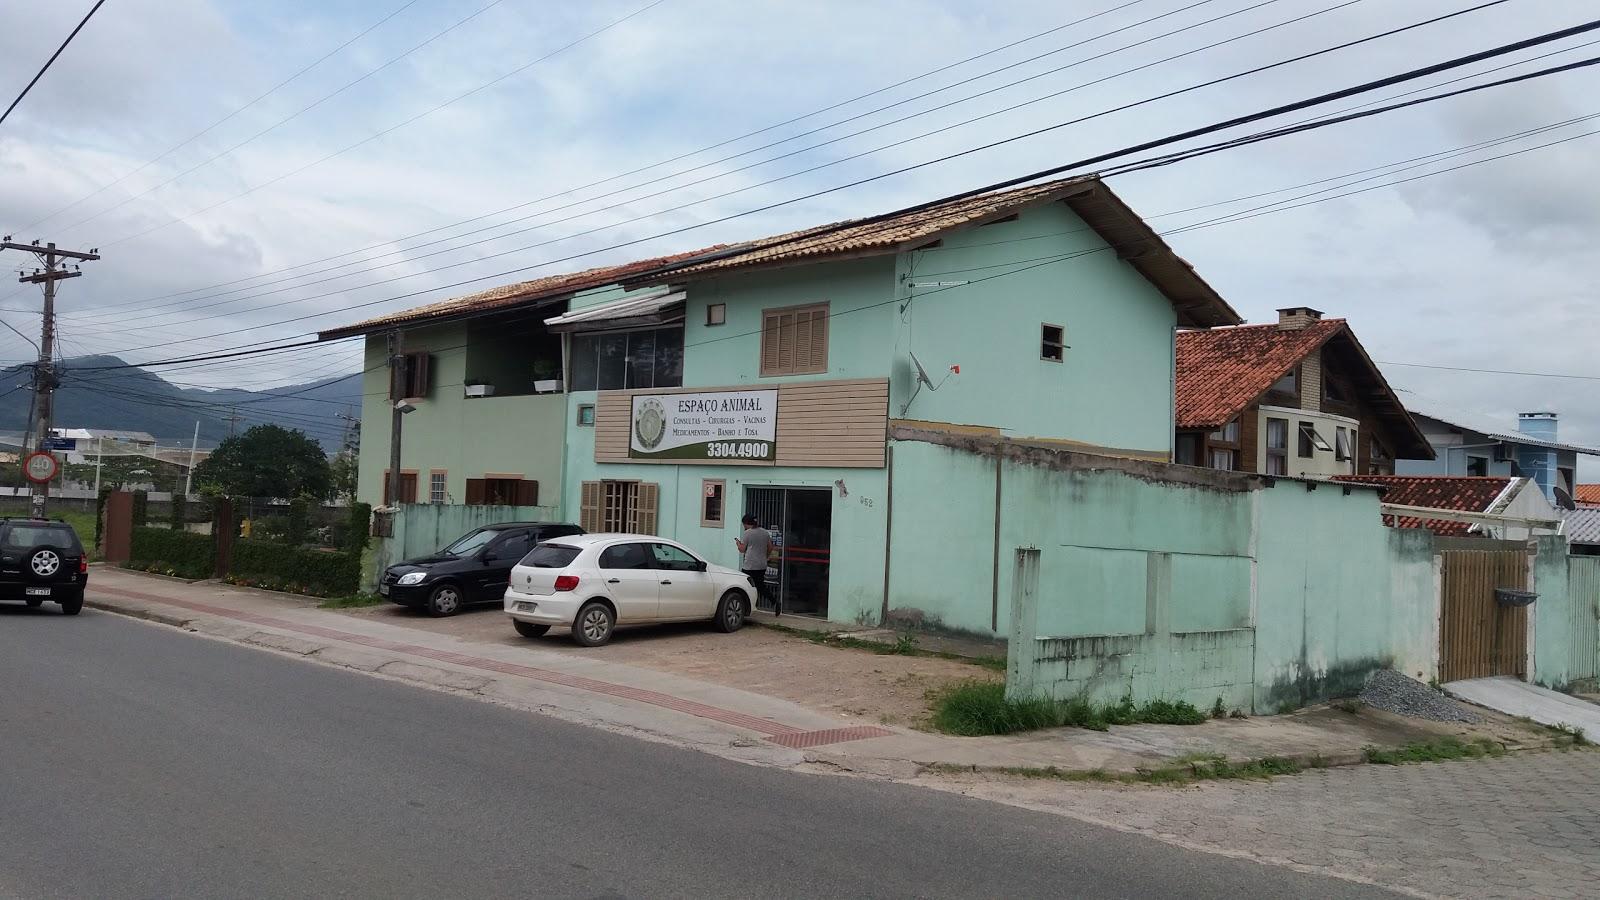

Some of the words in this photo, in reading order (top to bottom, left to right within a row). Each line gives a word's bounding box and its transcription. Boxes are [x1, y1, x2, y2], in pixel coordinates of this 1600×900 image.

[678, 399, 718, 415] ESPAÇO
[720, 397, 762, 413] ANIMAL
[673, 416, 701, 425] CONSULTAS
[743, 415, 767, 424] VACINAS
[672, 428, 710, 437] MEDICAMENTOS
[717, 428, 736, 436] BANHO
[744, 428, 758, 436] TOSA
[707, 442, 769, 458] 3304.4900
[31, 458, 49, 470] 40
